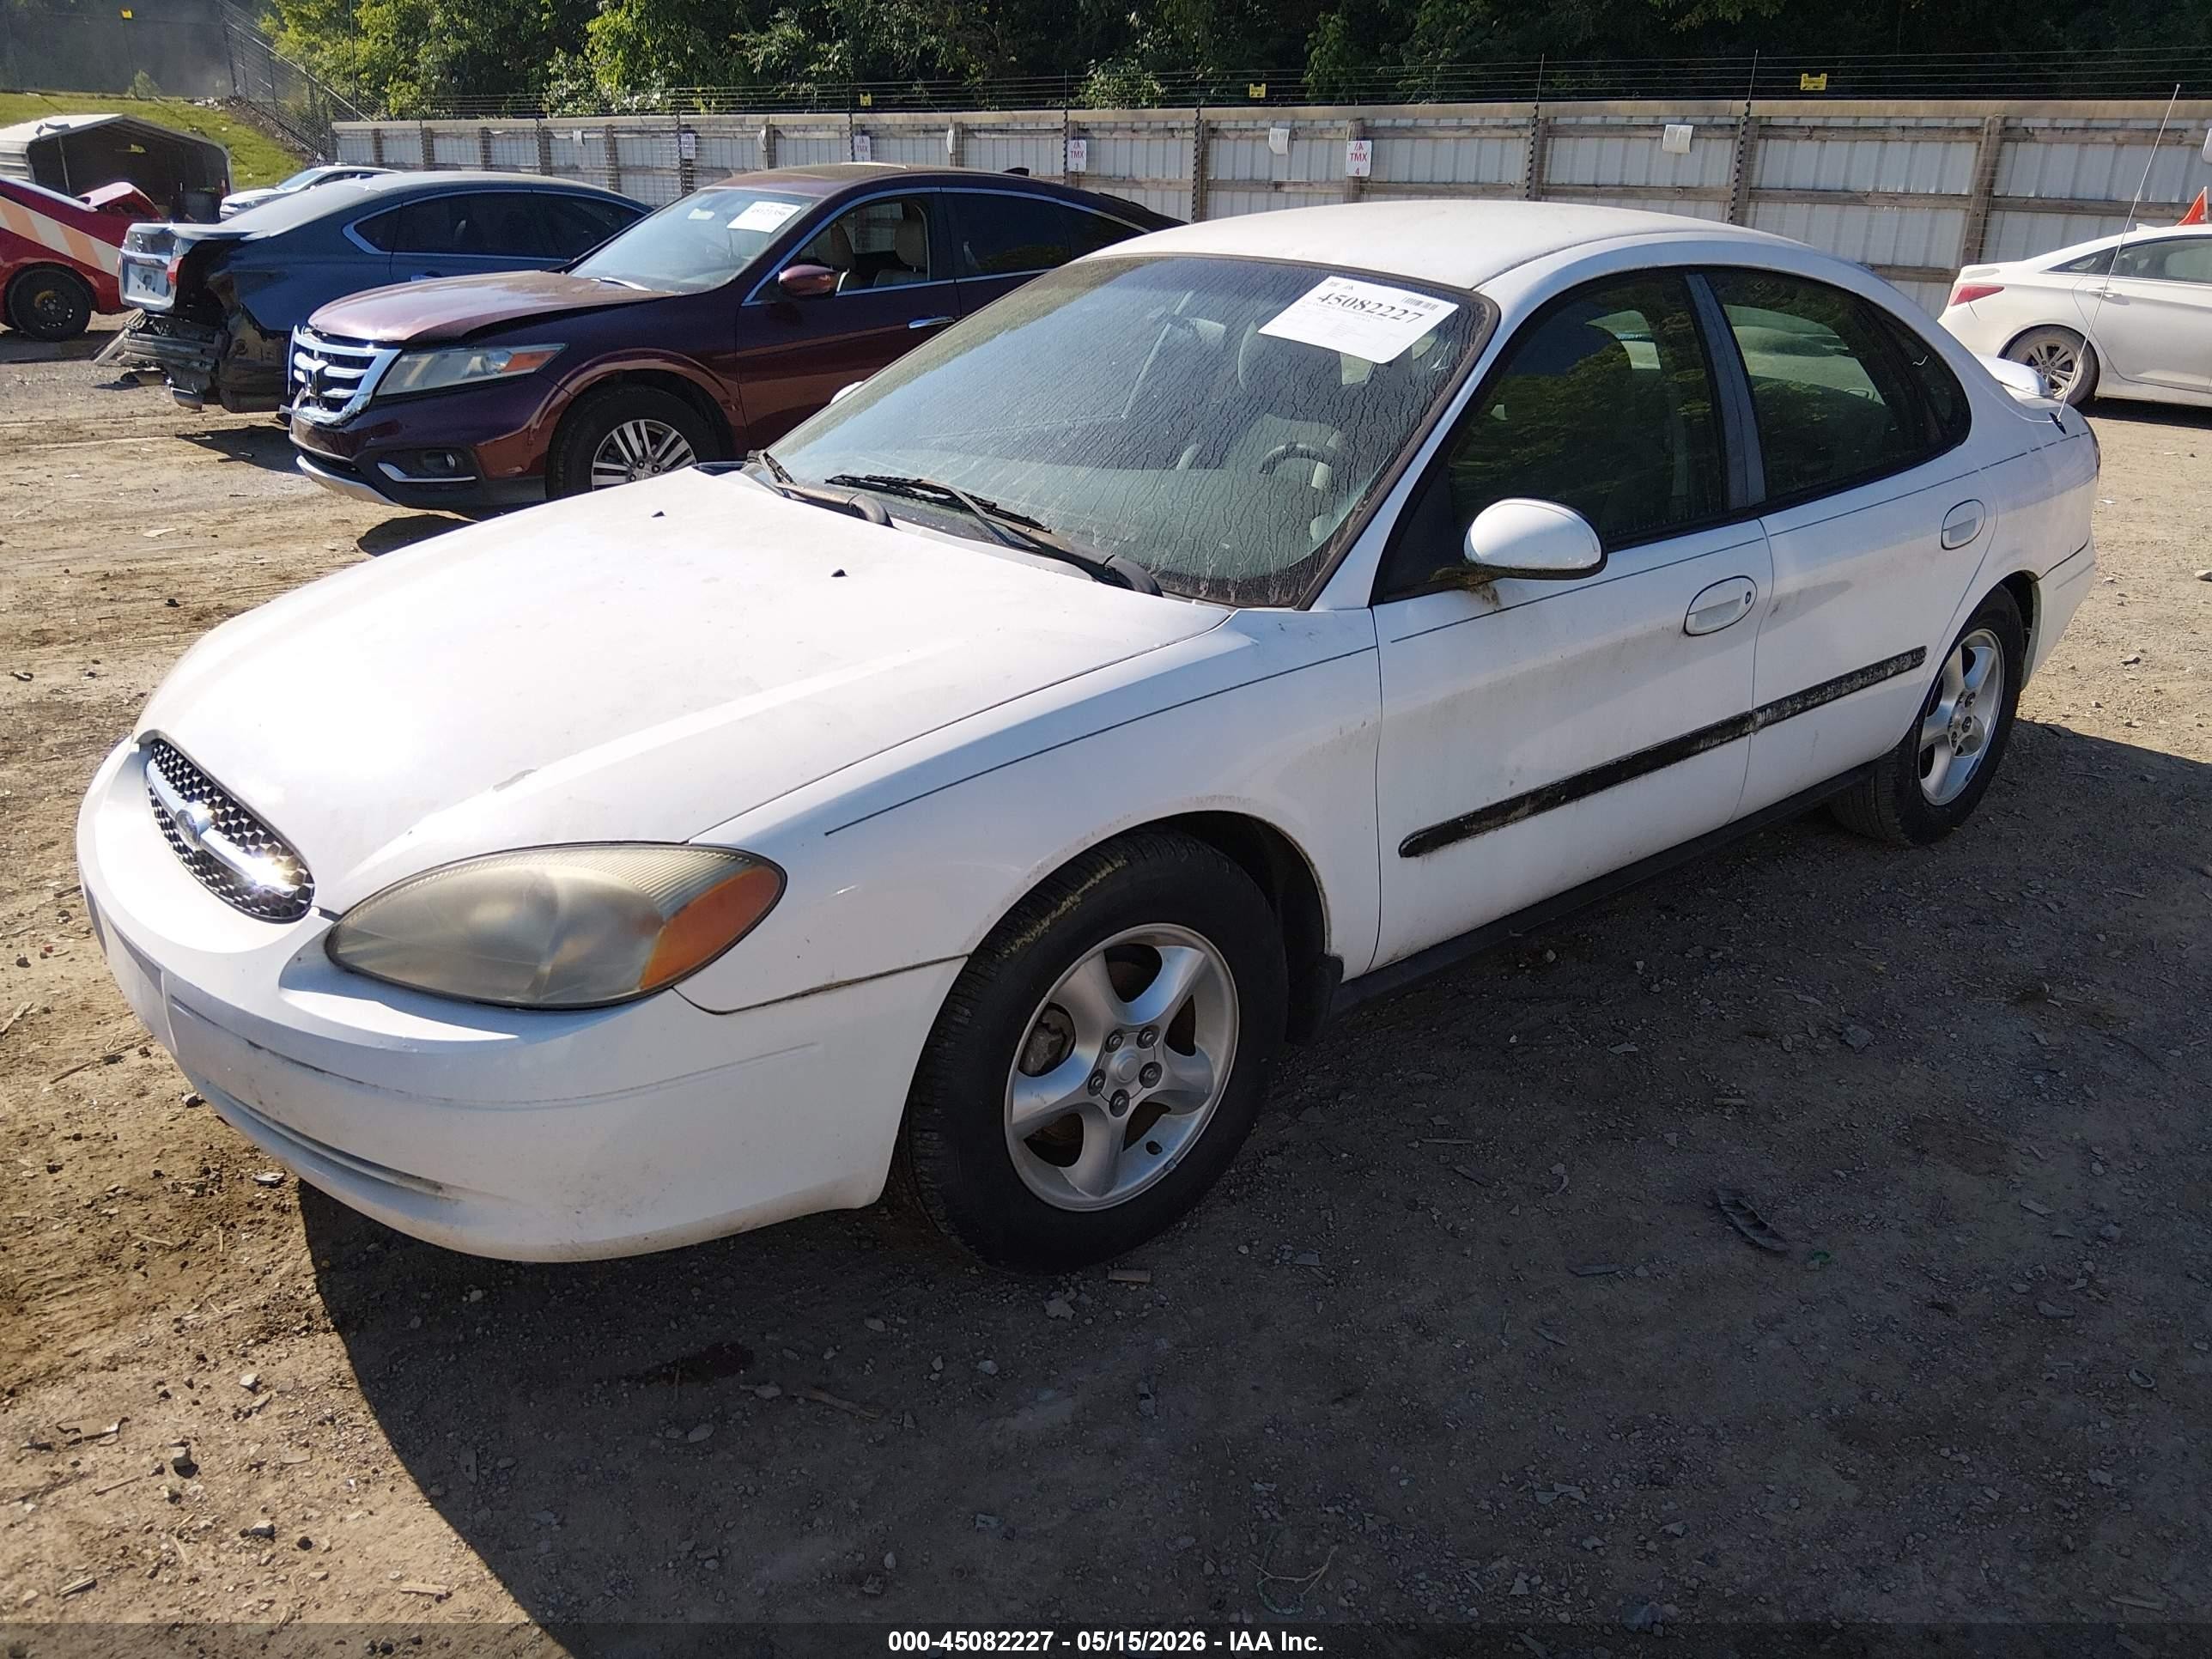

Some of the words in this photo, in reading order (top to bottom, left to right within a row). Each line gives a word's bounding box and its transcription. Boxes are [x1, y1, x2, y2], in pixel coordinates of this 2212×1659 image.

[1071, 150, 1084, 159] TMX
[1350, 152, 1367, 161] TMX
[1317, 293, 1424, 323] 45082227
